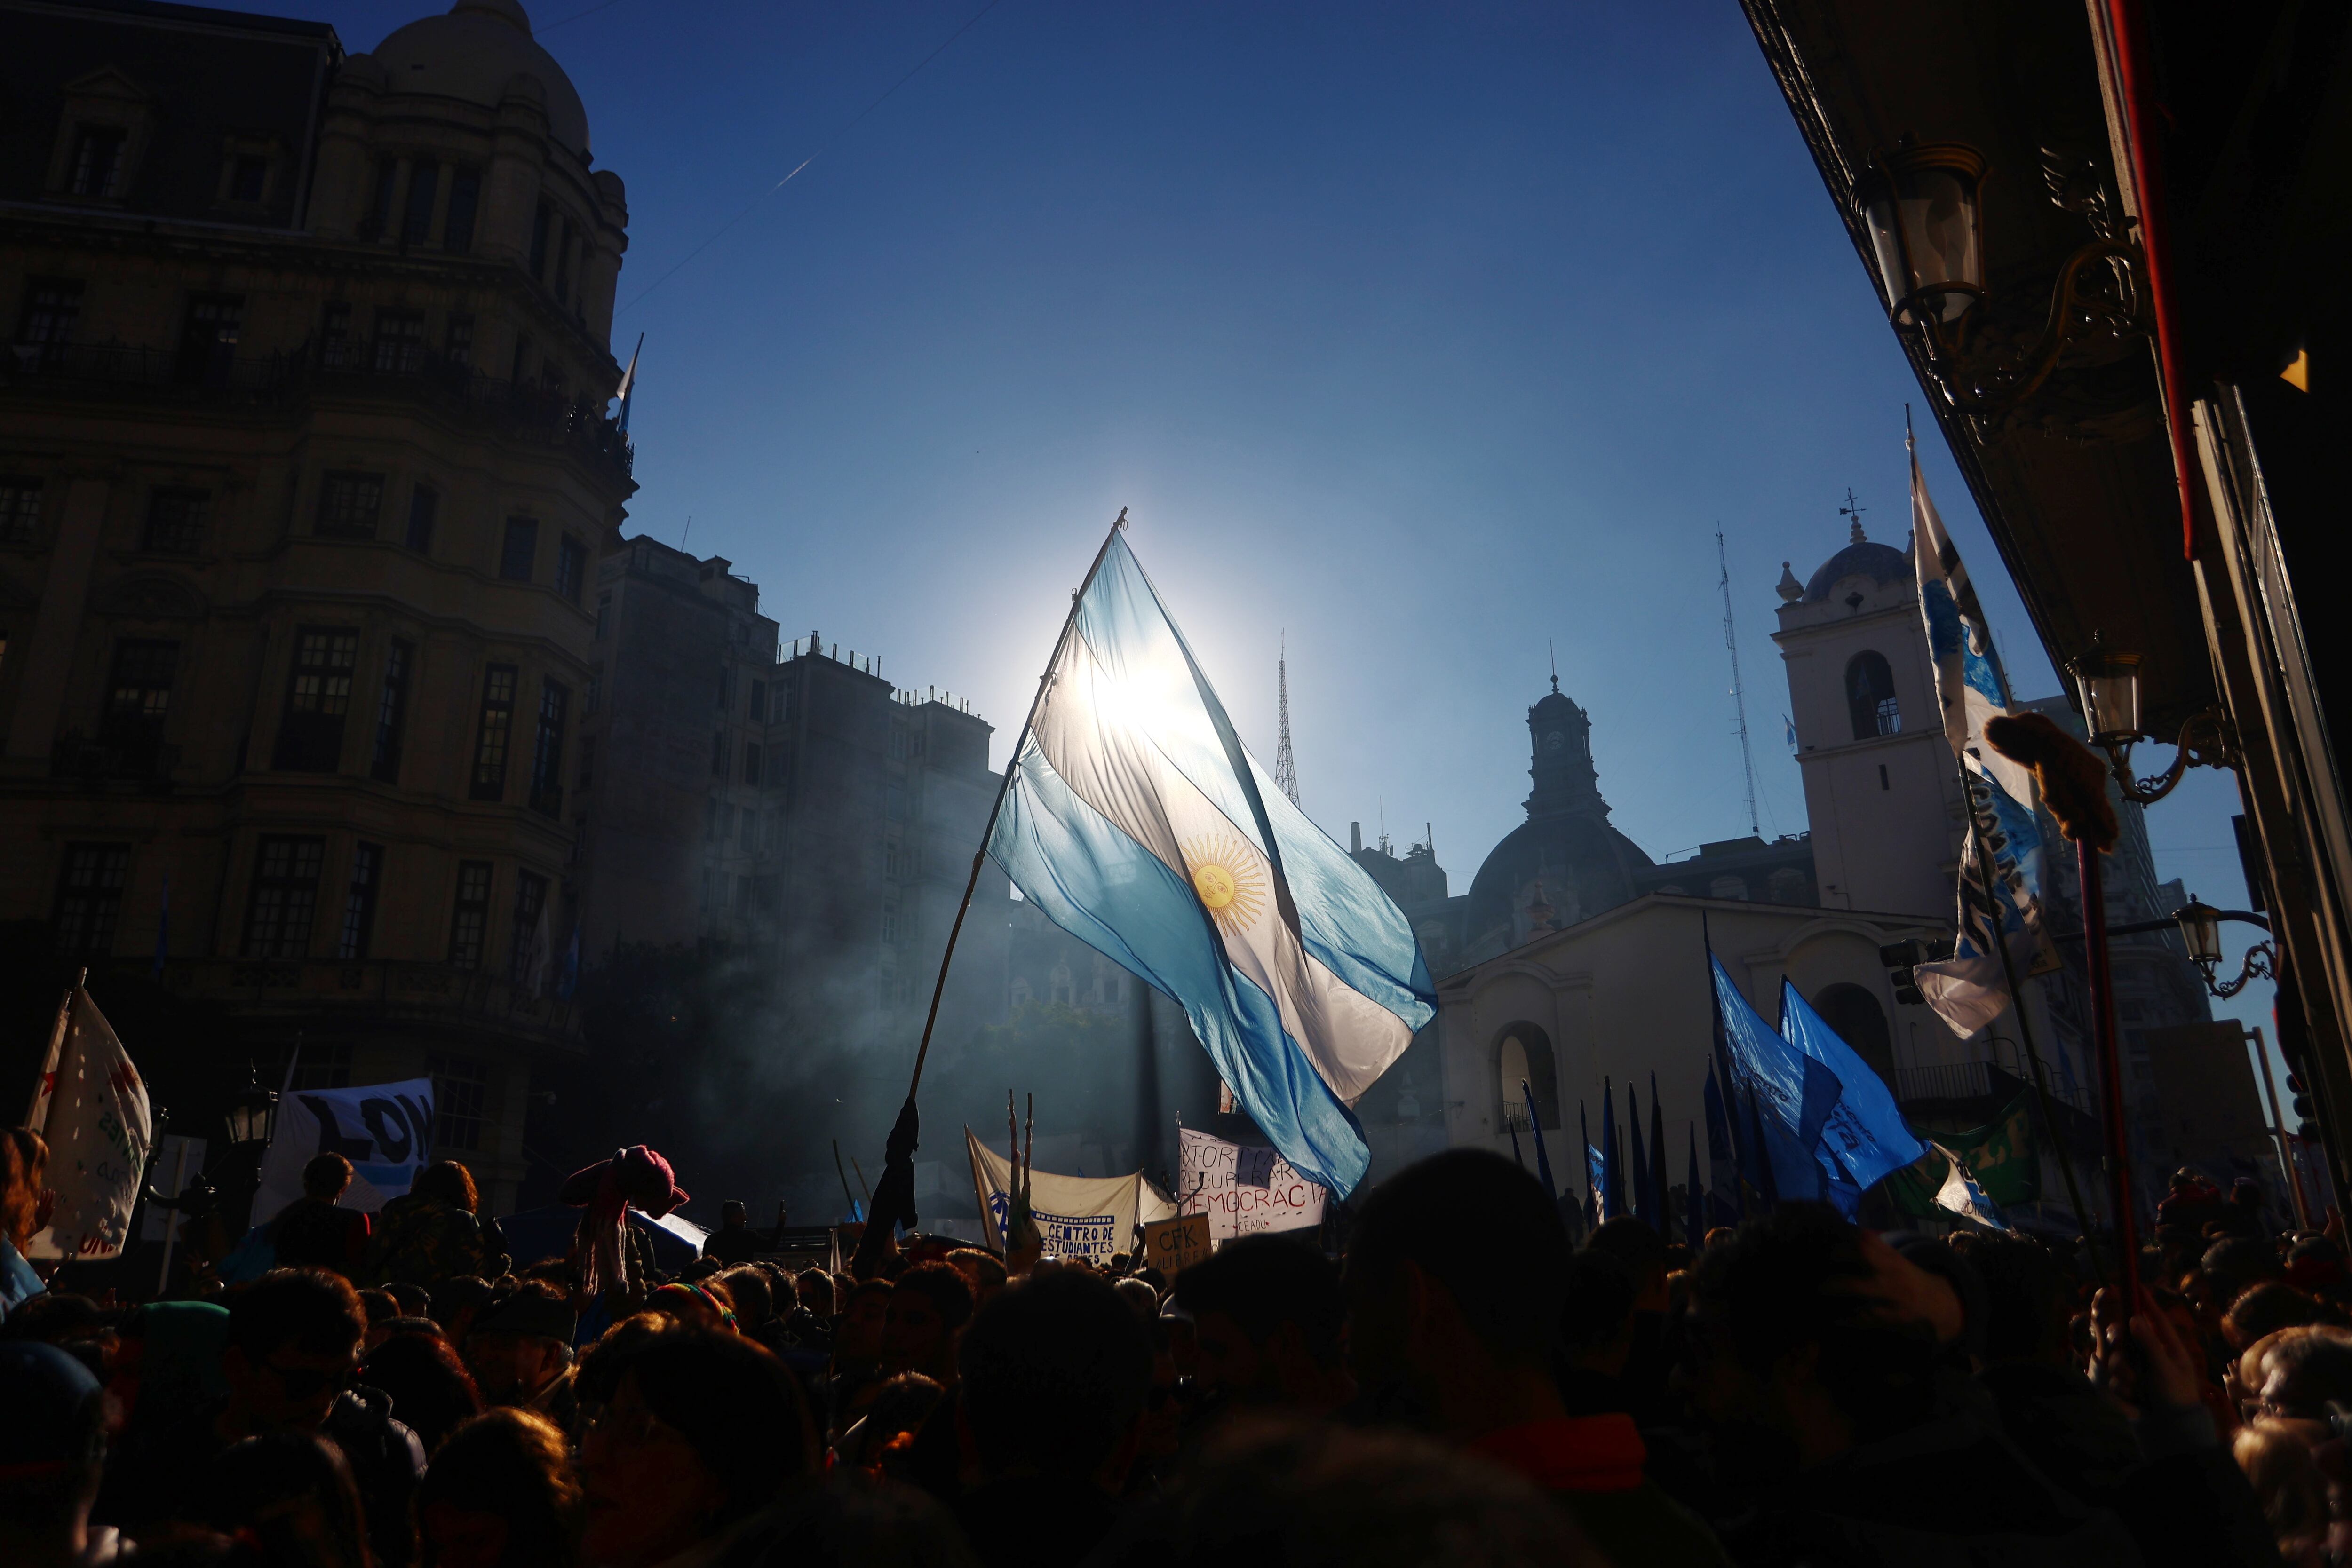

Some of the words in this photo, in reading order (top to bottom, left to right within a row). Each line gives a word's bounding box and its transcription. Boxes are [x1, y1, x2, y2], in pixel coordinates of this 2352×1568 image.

[1049, 1224, 1098, 1241] CENTRO
[1103, 1227, 1114, 1241] DE
[1238, 1219, 1267, 1232] CEADU
[1041, 1237, 1113, 1254] ESTUDIANTES
[1159, 1224, 1198, 1251] CFK
